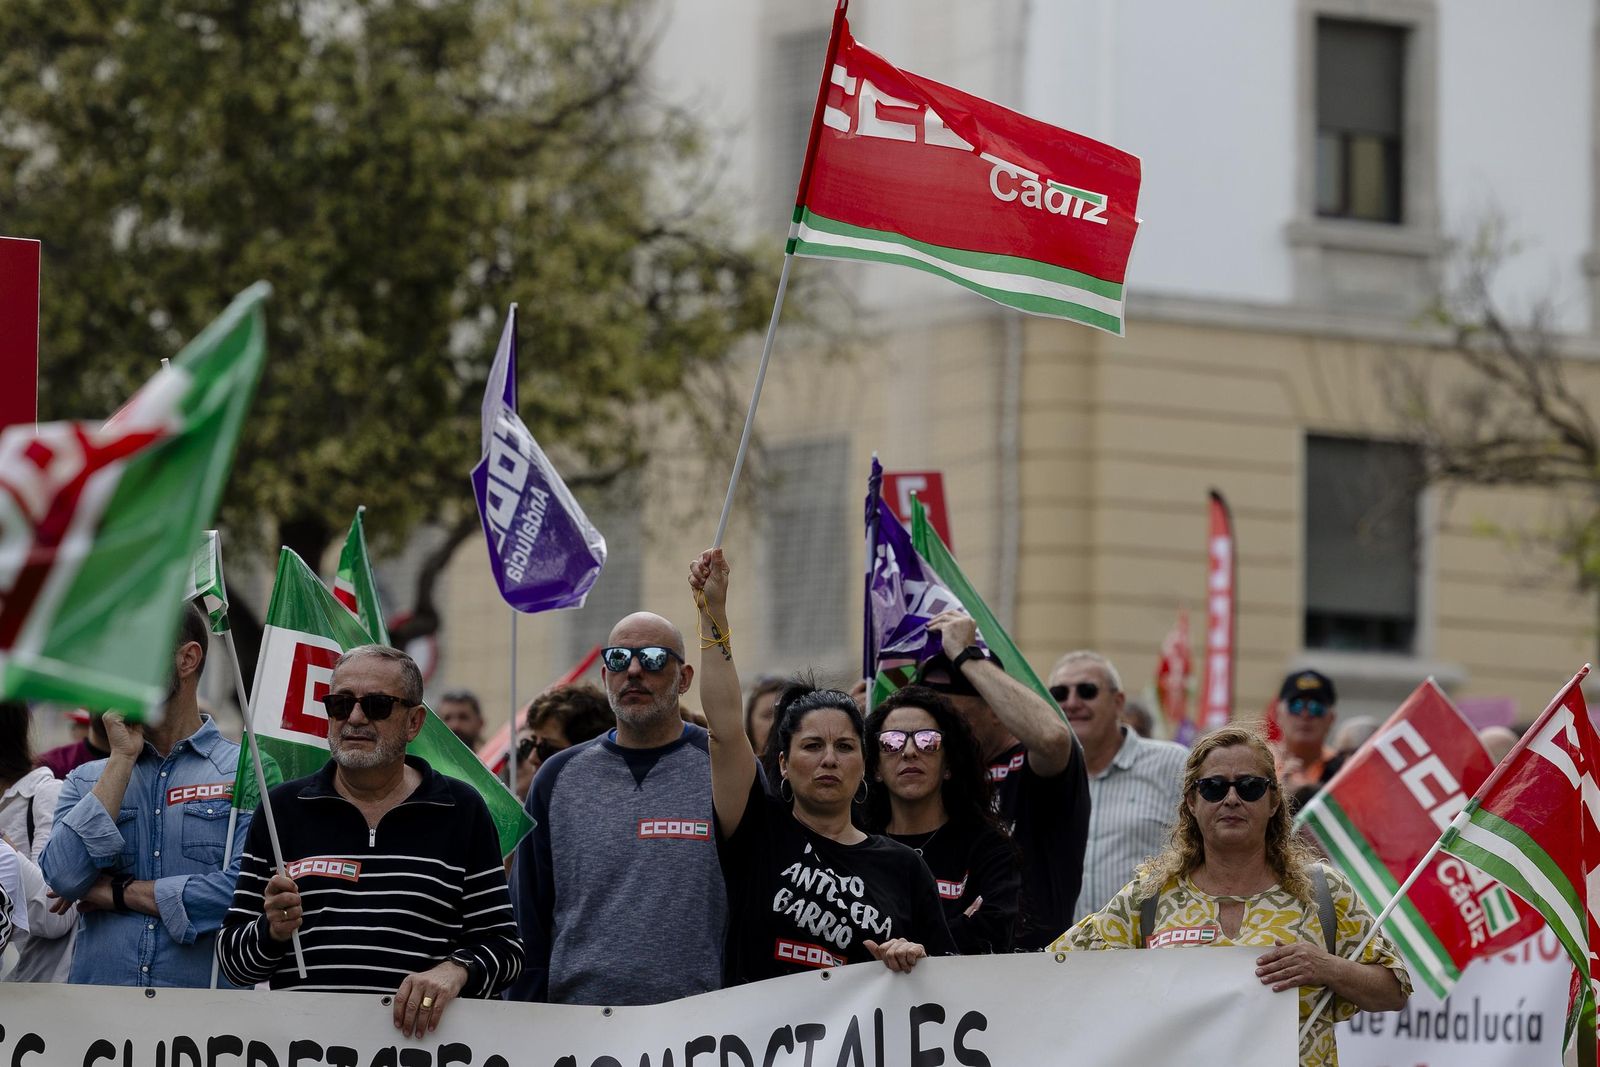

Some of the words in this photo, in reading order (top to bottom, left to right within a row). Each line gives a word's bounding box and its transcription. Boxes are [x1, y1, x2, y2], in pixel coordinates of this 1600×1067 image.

[170, 784, 223, 801] CCOO
[641, 821, 695, 835] CCOO
[289, 860, 342, 877] CCOO
[1436, 857, 1486, 949] Cádiz
[1149, 929, 1200, 949] CCOO
[1395, 997, 1544, 1043] Andalucía
